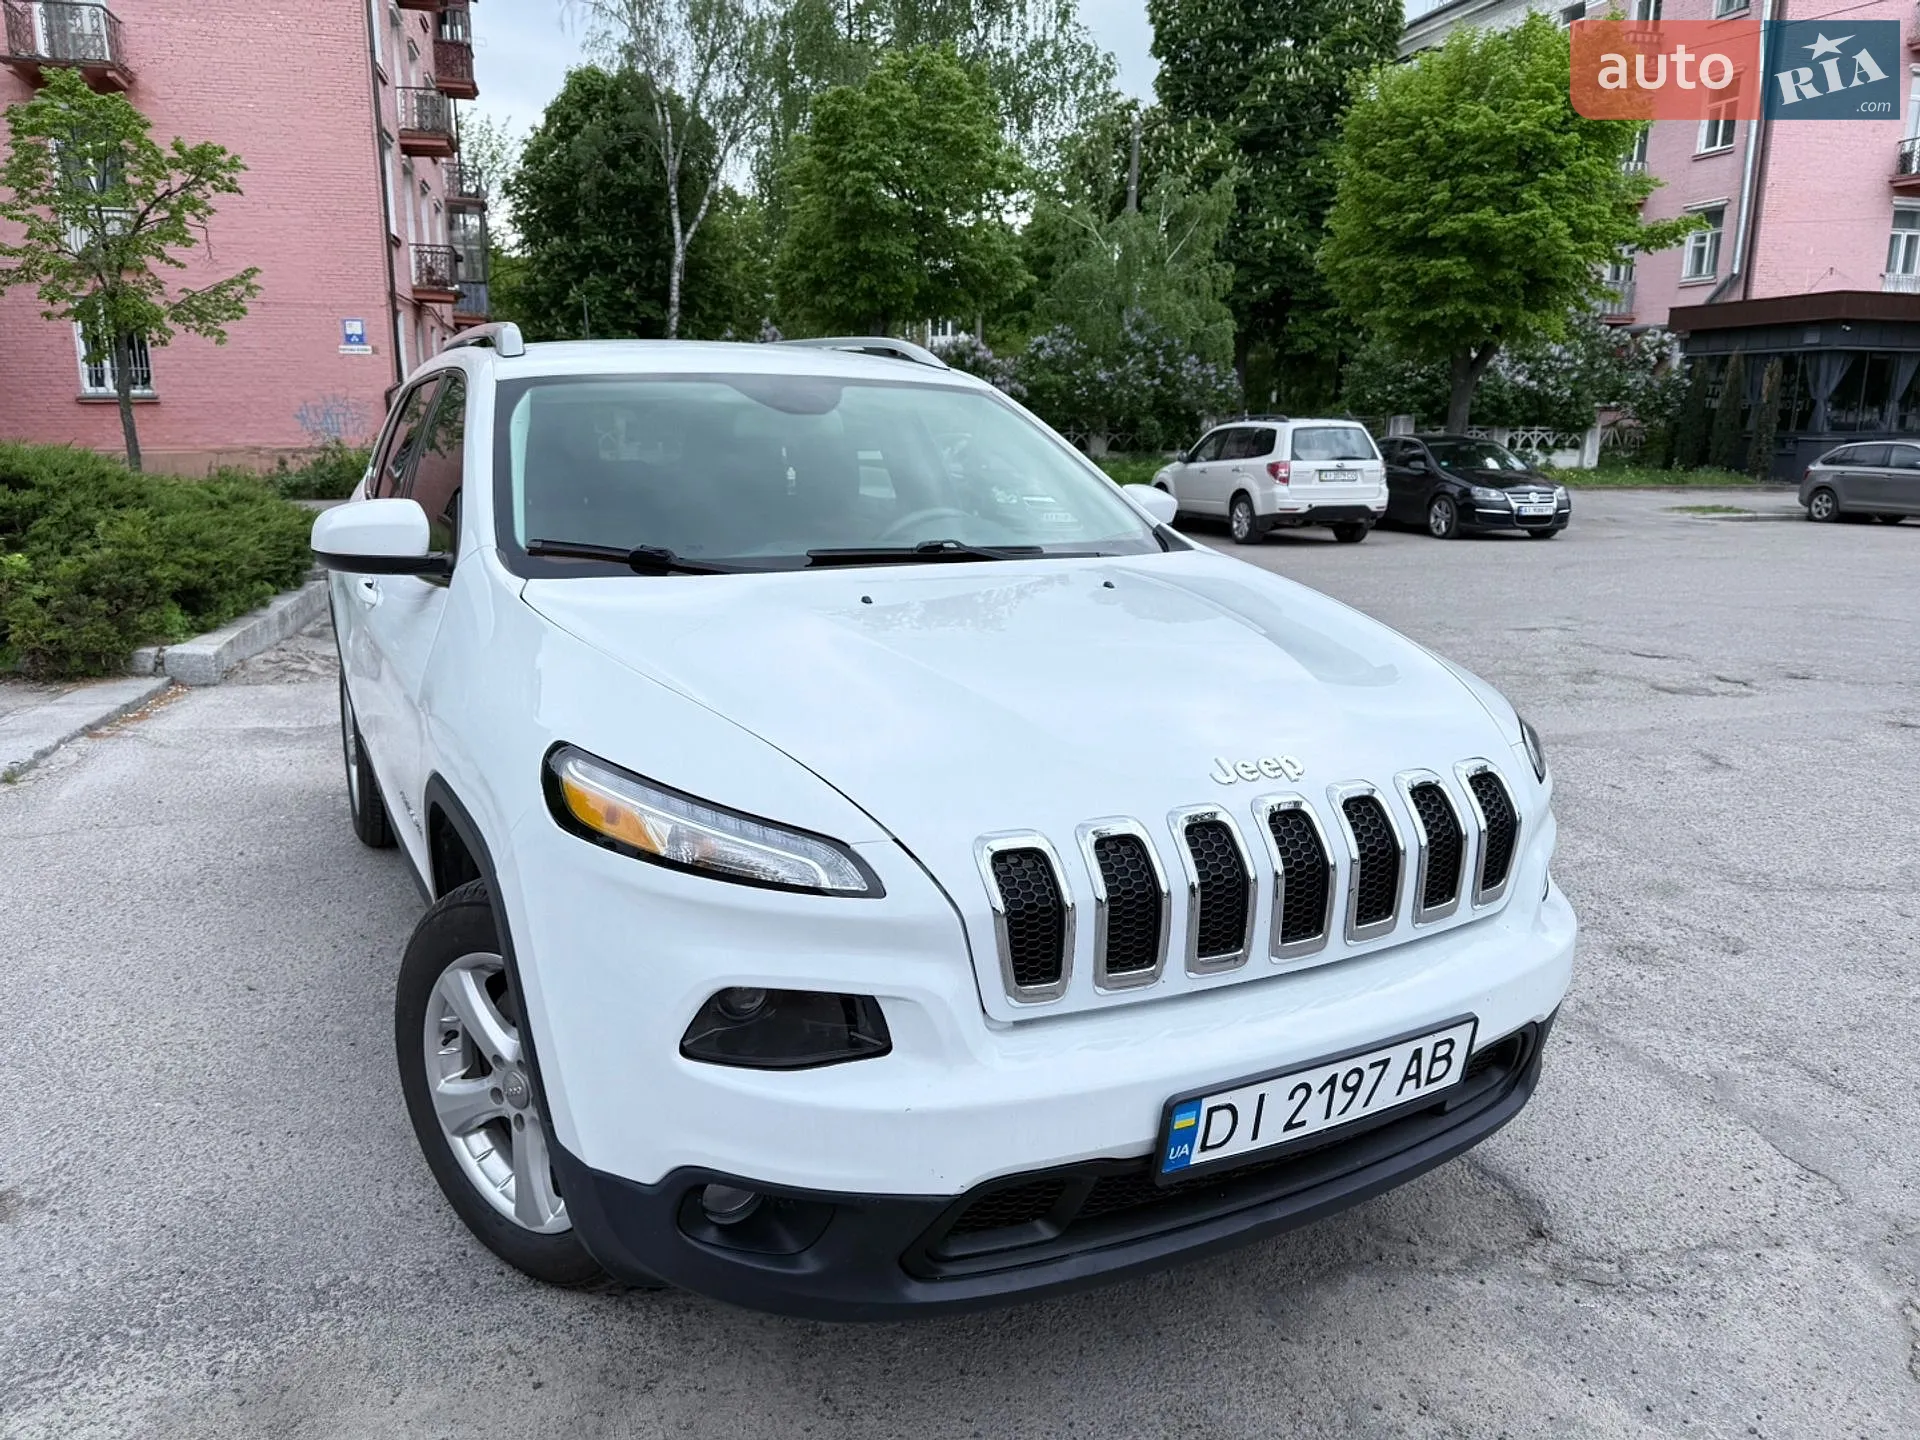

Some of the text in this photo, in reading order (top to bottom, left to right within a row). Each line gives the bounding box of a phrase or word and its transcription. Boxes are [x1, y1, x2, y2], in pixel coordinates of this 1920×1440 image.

[1209, 754, 1305, 786] Jeep
[1198, 1037, 1455, 1154] DI 2197 AB
[1169, 1143, 1190, 1161] UA
